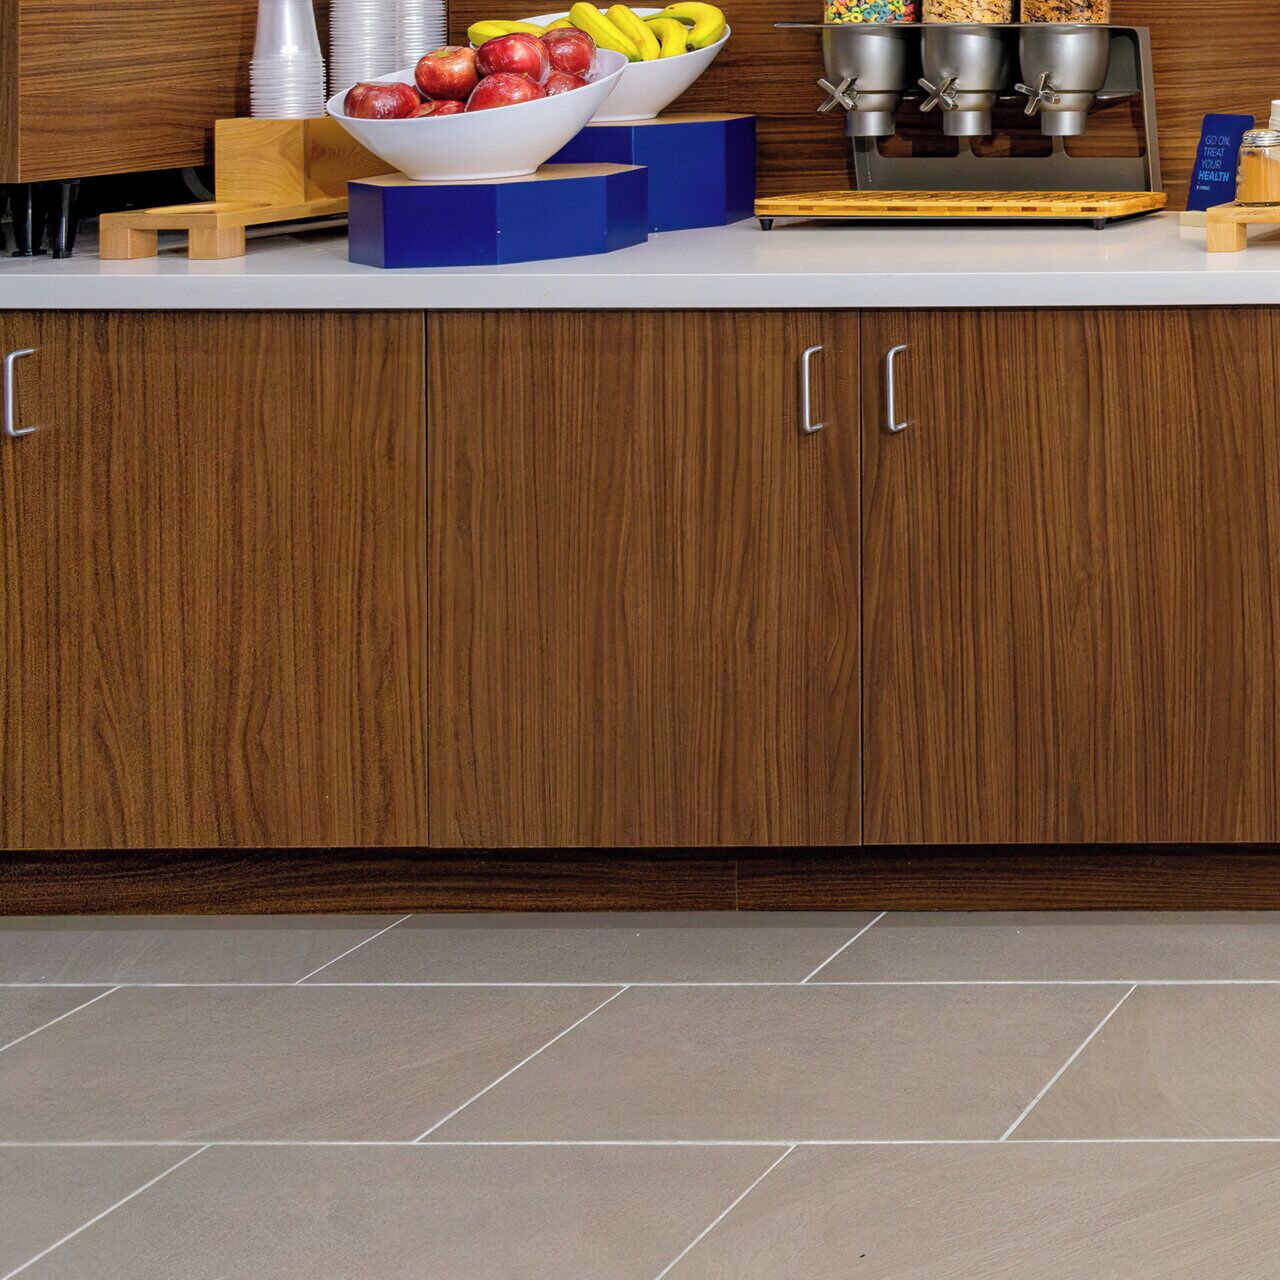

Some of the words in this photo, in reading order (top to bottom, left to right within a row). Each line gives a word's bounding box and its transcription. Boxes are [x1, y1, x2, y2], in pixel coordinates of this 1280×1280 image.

[1205, 135, 1217, 146] GO
[1203, 147, 1226, 158] TREAT
[1201, 159, 1222, 169] YOUR
[1198, 170, 1230, 182] HEALTH
